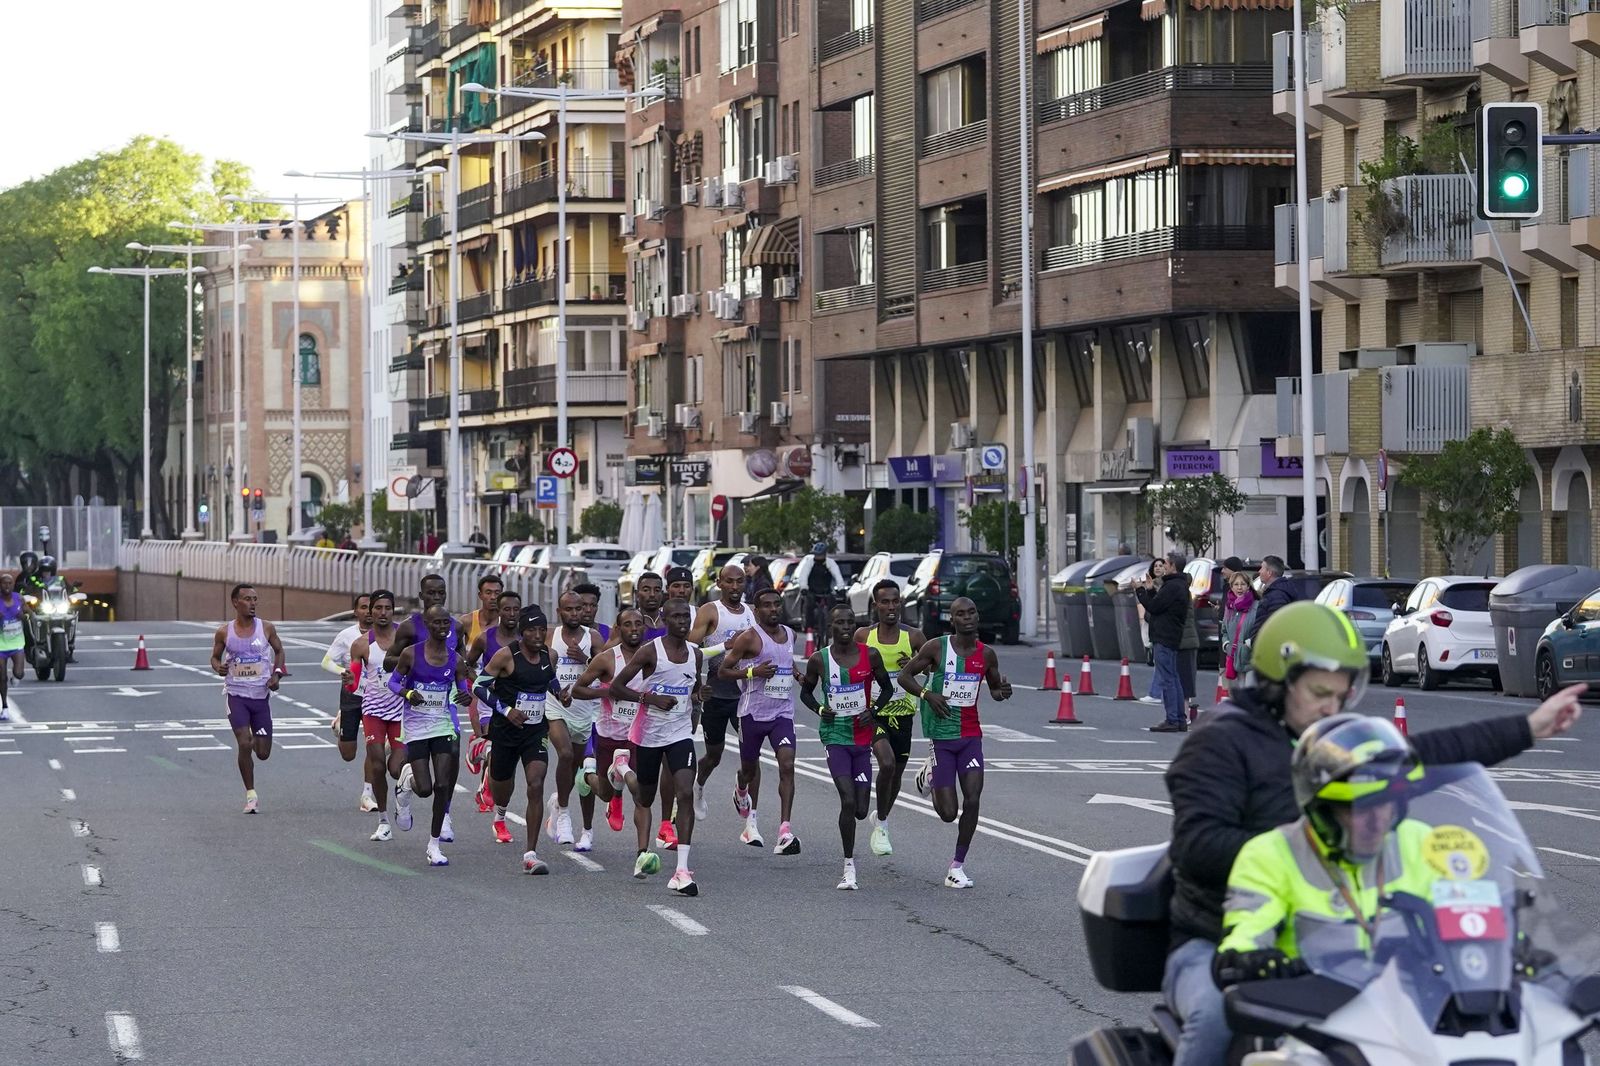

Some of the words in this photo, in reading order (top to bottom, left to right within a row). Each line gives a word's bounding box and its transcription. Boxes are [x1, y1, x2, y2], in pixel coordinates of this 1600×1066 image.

[671, 463, 705, 472] TINTE
[539, 479, 552, 497] P
[839, 684, 860, 692] ZURICH
[950, 691, 972, 699] PACER
[836, 701, 859, 709] PACER
